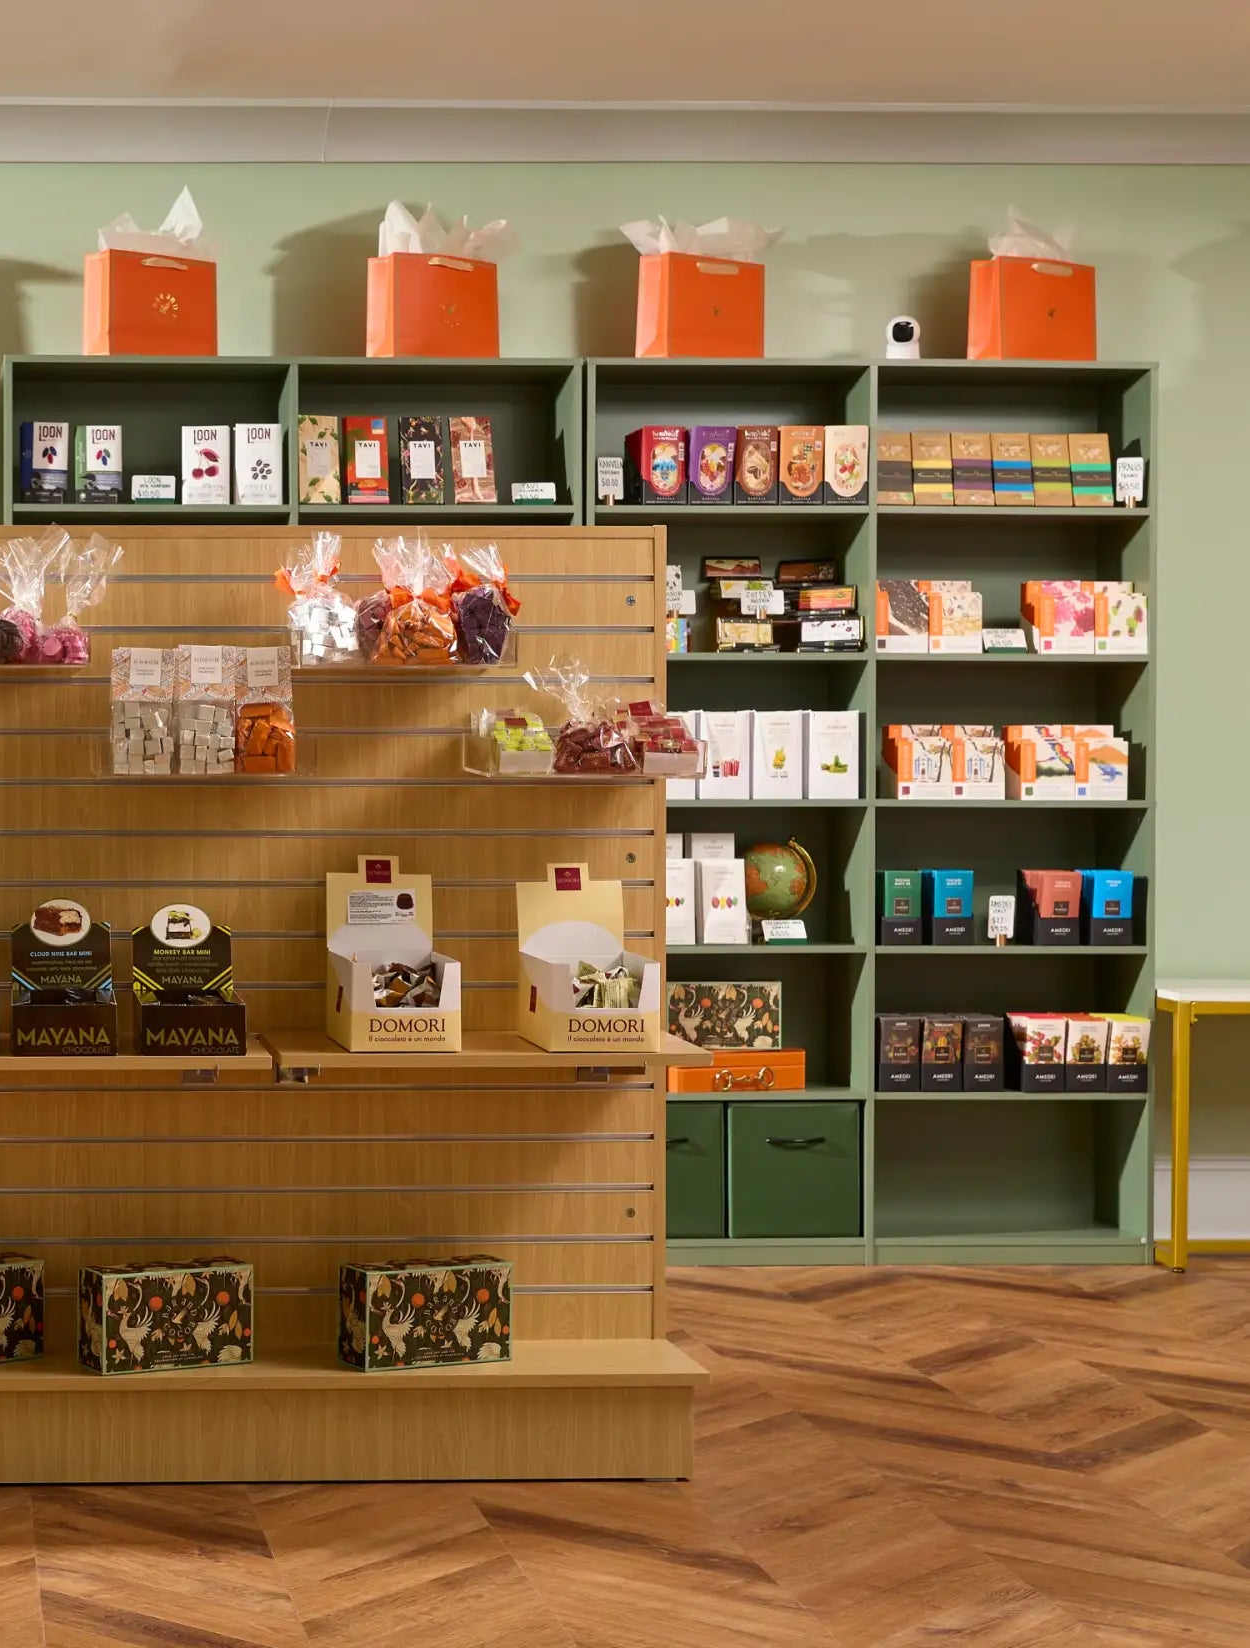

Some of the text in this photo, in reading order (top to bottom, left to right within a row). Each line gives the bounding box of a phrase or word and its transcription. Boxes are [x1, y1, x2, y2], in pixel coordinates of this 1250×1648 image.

[39, 425, 63, 441] LOON
[92, 429, 116, 444] LOON
[193, 429, 217, 445] LOON
[247, 427, 271, 444] LOON
[40, 974, 82, 984] MAYANA
[161, 975, 203, 985] MAYANA
[369, 1018, 446, 1033] DOMORI
[568, 1018, 645, 1033] DOMORI
[16, 1027, 111, 1047] MAYANA
[146, 1027, 240, 1046] MAYANA
[62, 1045, 111, 1055] CHOCOLATE
[190, 1046, 240, 1055] CHOCOLATE
